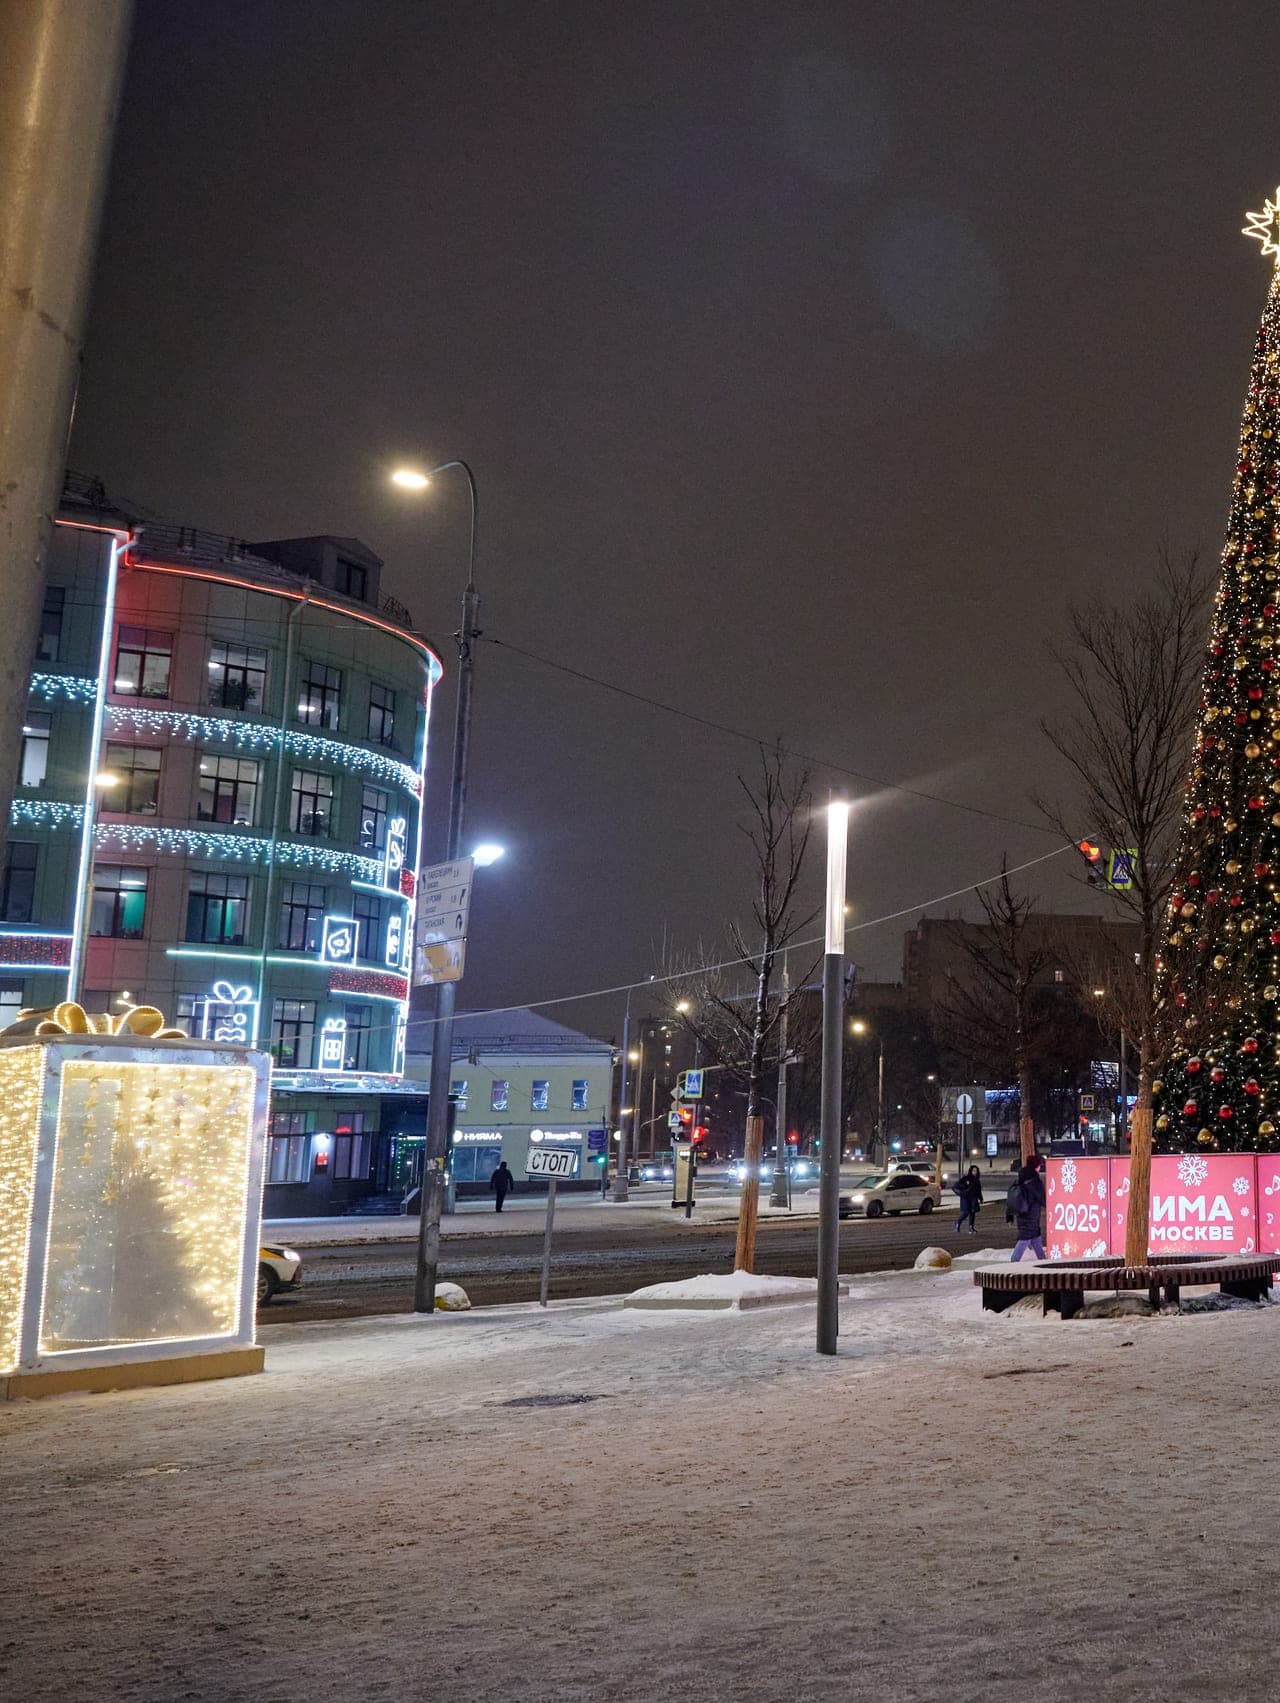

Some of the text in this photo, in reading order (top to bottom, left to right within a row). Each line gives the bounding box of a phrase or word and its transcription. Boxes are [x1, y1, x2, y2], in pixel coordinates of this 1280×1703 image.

[532, 1152, 569, 1172] СТОП
[1054, 1202, 1100, 1233] 2025
[1149, 1195, 1234, 1222] ИМА
[1151, 1225, 1234, 1242] МОСКВЕ
